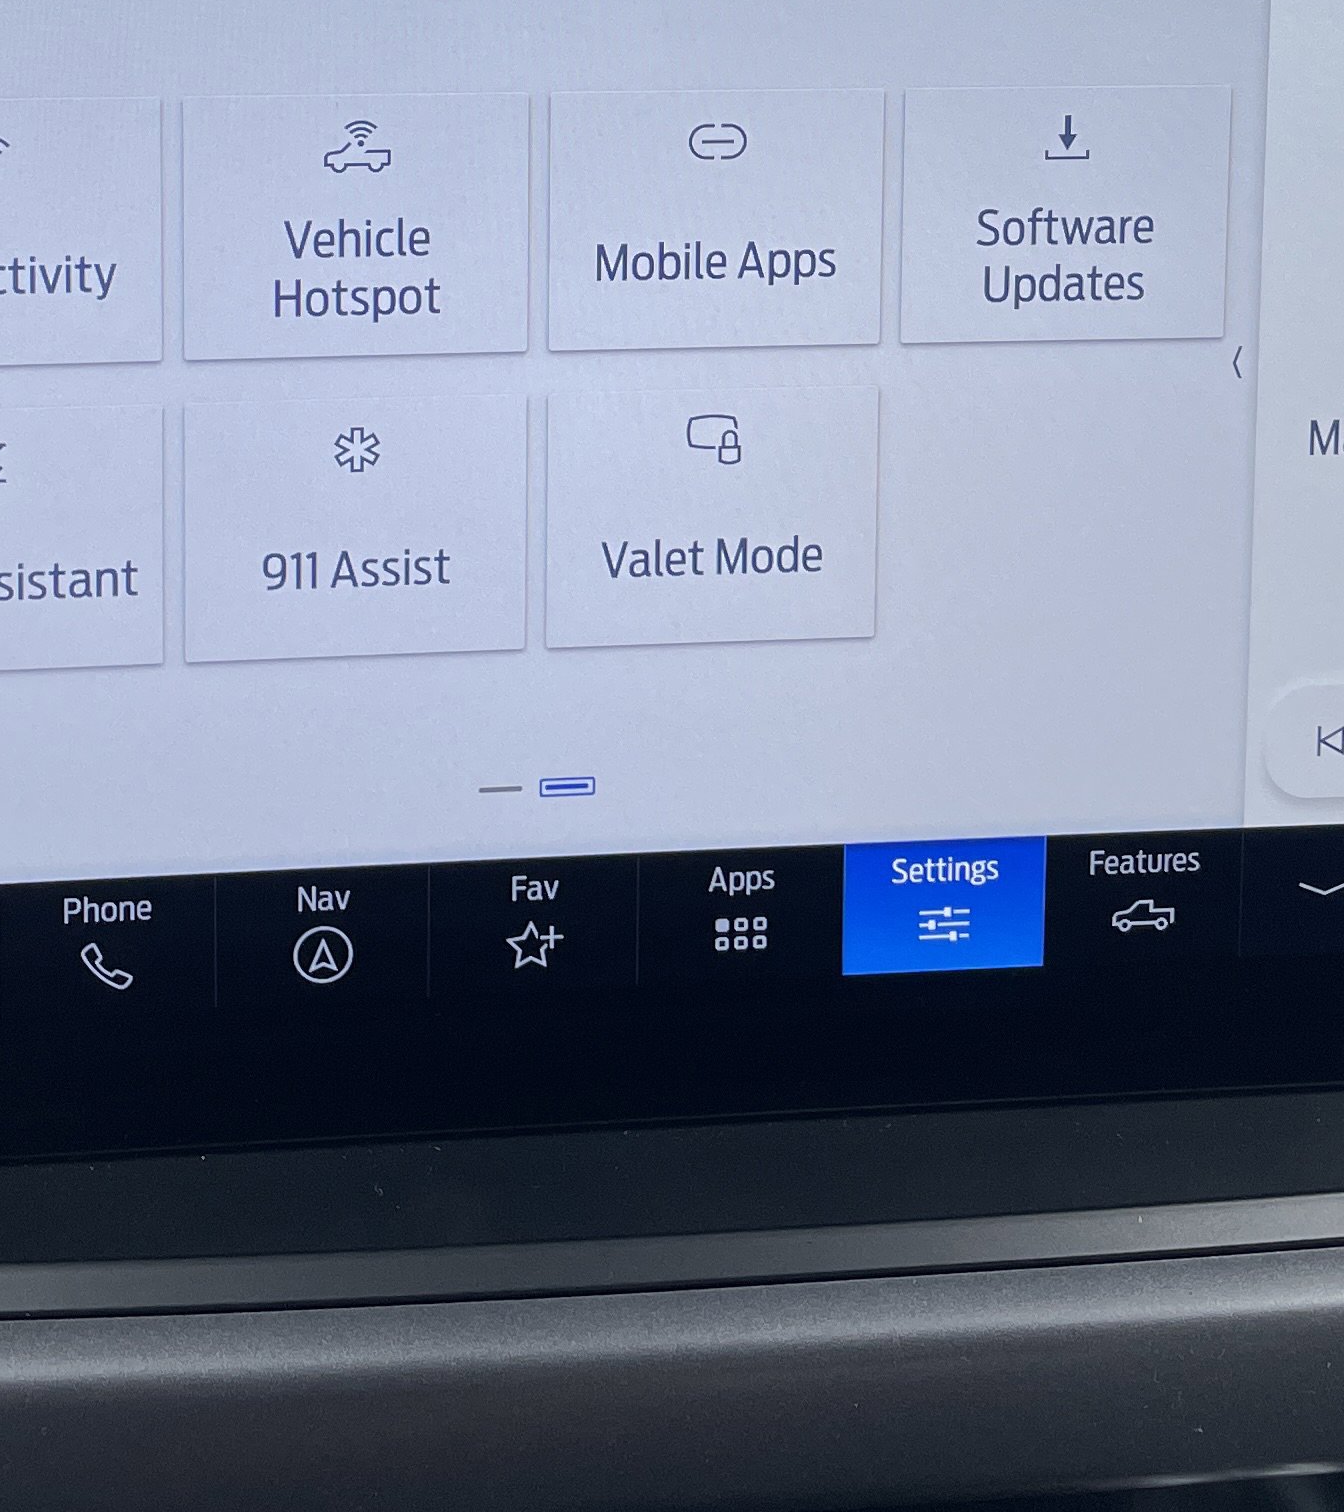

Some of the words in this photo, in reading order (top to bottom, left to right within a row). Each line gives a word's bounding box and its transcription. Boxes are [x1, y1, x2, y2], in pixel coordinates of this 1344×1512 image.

[283, 217, 431, 260] Vehicle
[976, 206, 1154, 247] Software
[596, 240, 727, 282] Mobile
[737, 240, 837, 286] Apps
[274, 277, 441, 324] Hotspot
[983, 263, 1145, 310] Updates
[262, 551, 318, 591] 911
[330, 548, 451, 589] Assist
[601, 538, 705, 579] Valet
[716, 534, 823, 576] Mode
[708, 866, 776, 897] Apps
[891, 856, 999, 886] Settings
[1089, 849, 1201, 876] Features
[297, 885, 351, 913] Nav
[511, 875, 560, 902] Fav
[63, 895, 152, 925] Phone
